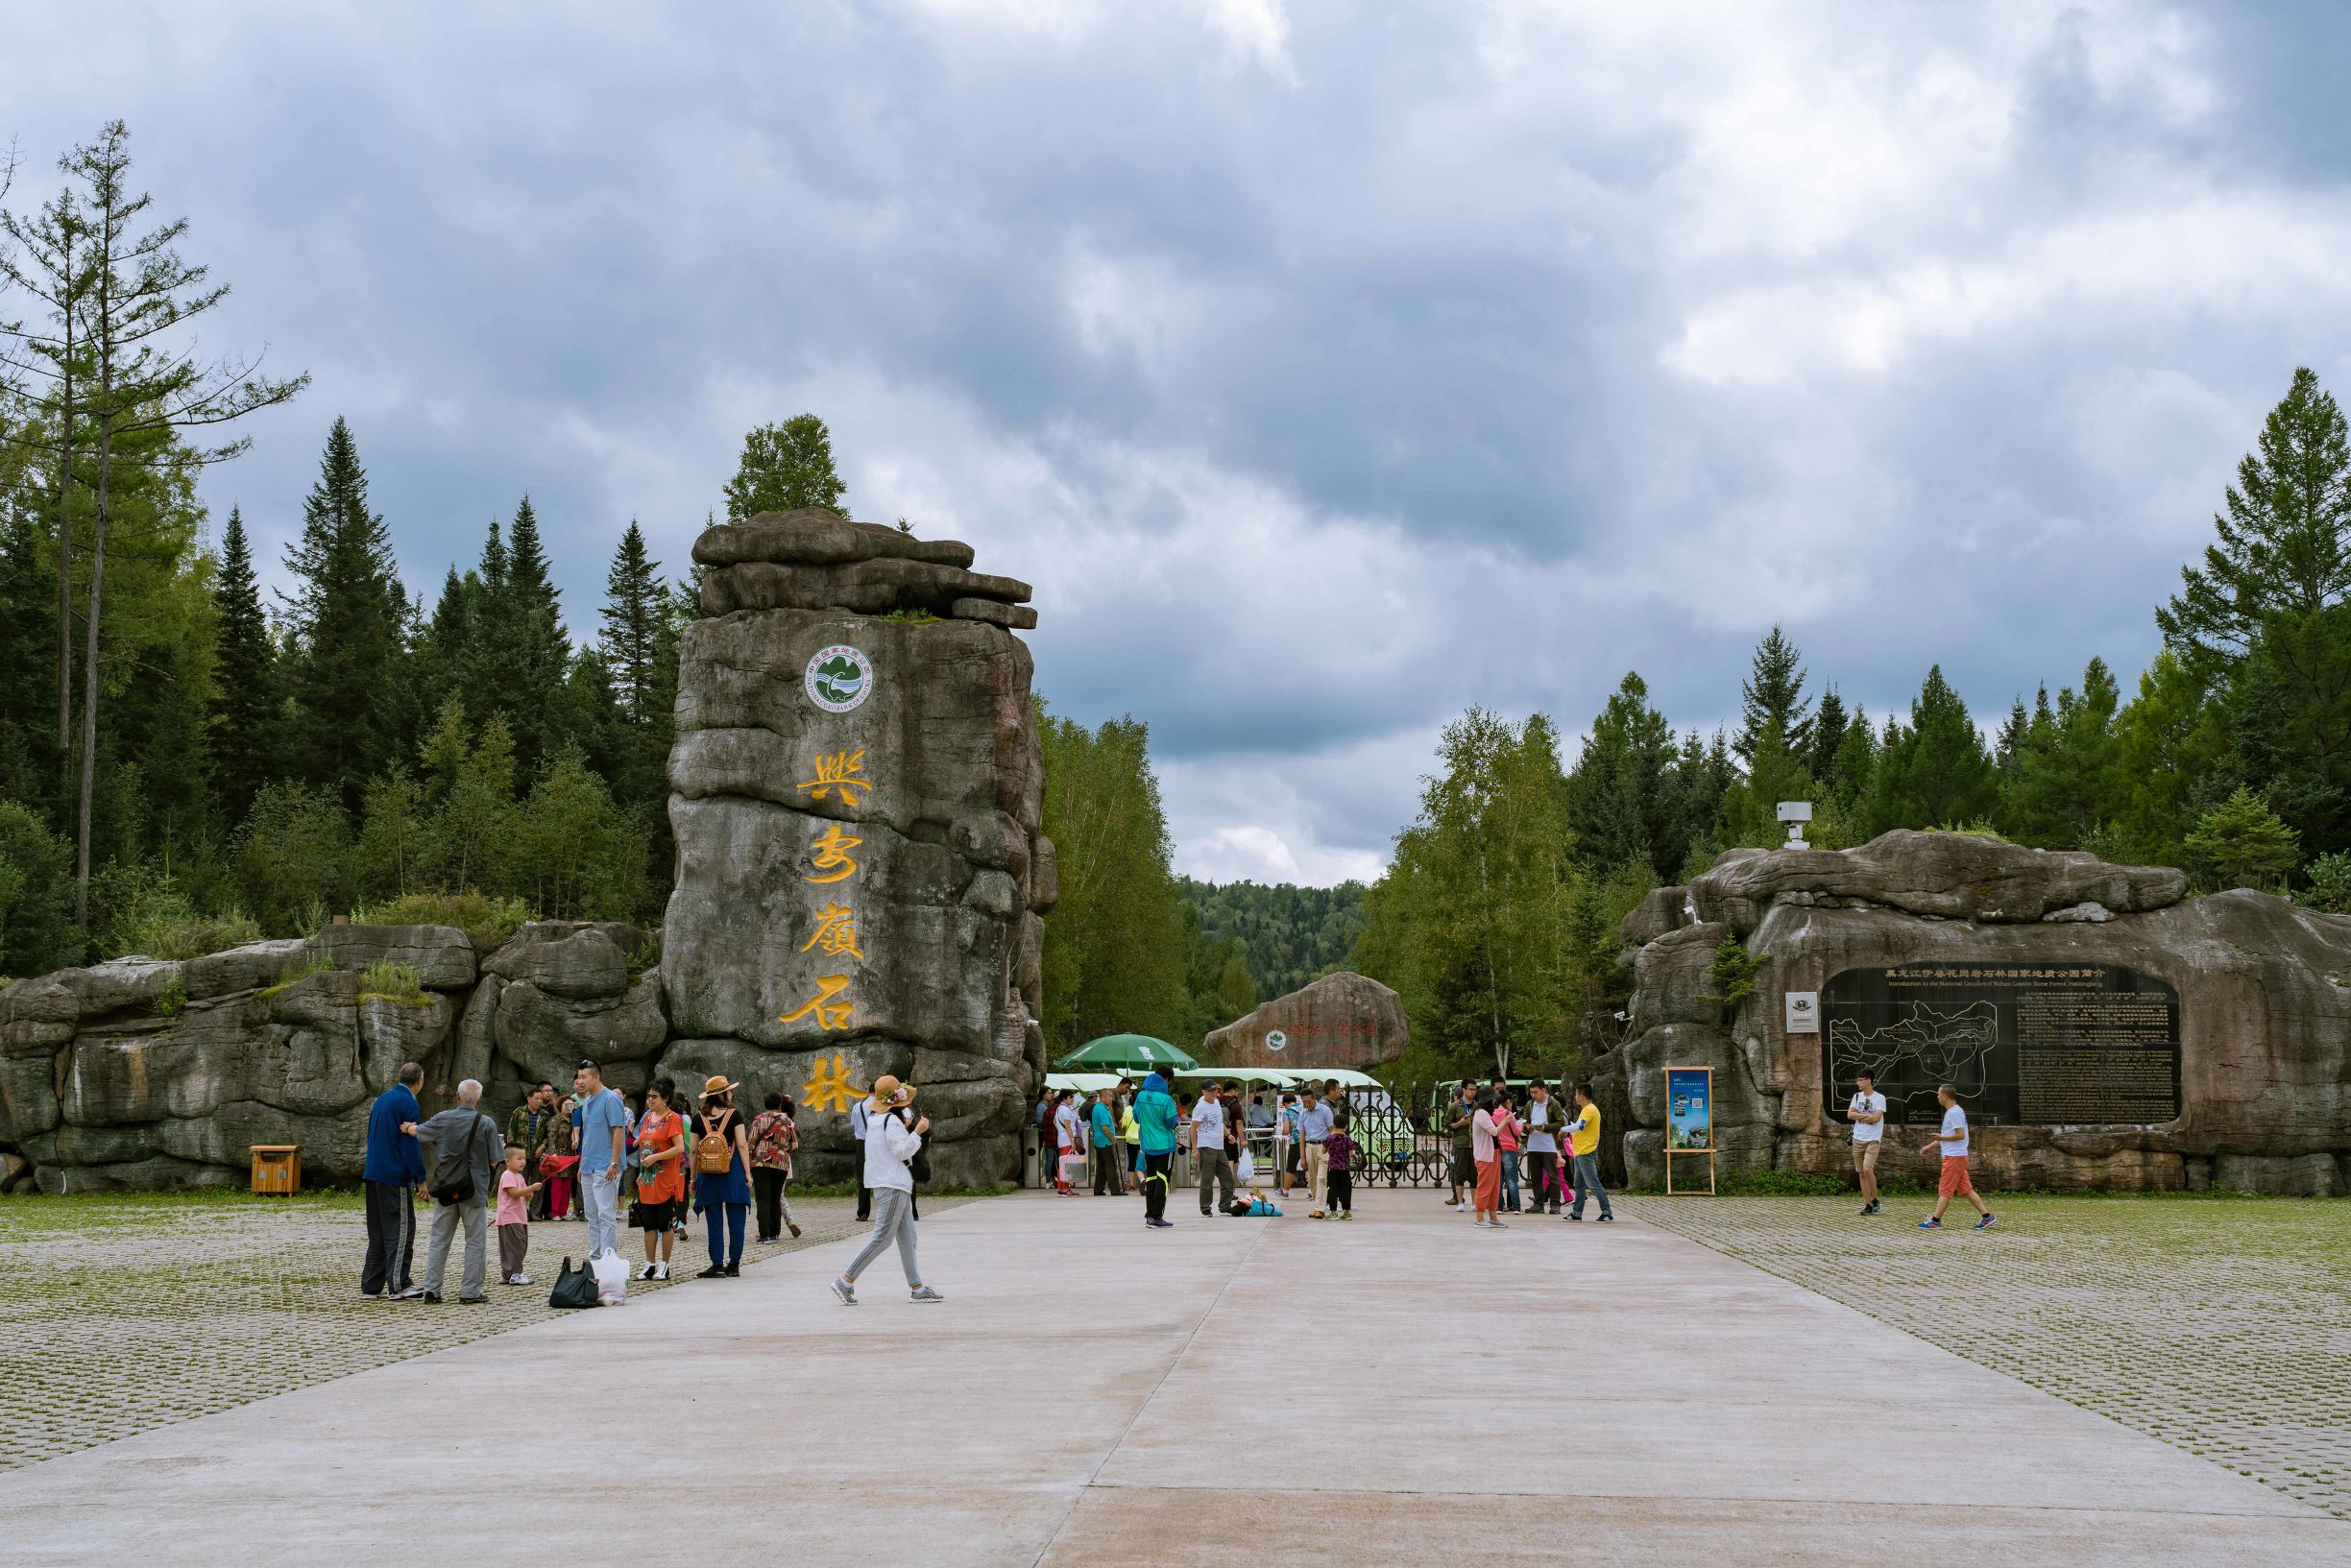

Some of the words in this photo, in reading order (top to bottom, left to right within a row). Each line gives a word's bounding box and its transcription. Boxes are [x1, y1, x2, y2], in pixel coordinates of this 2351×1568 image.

[809, 647, 871, 674] 中国国家地质公园
[807, 676, 824, 707] NATIONAL
[860, 679, 871, 699] CHINA
